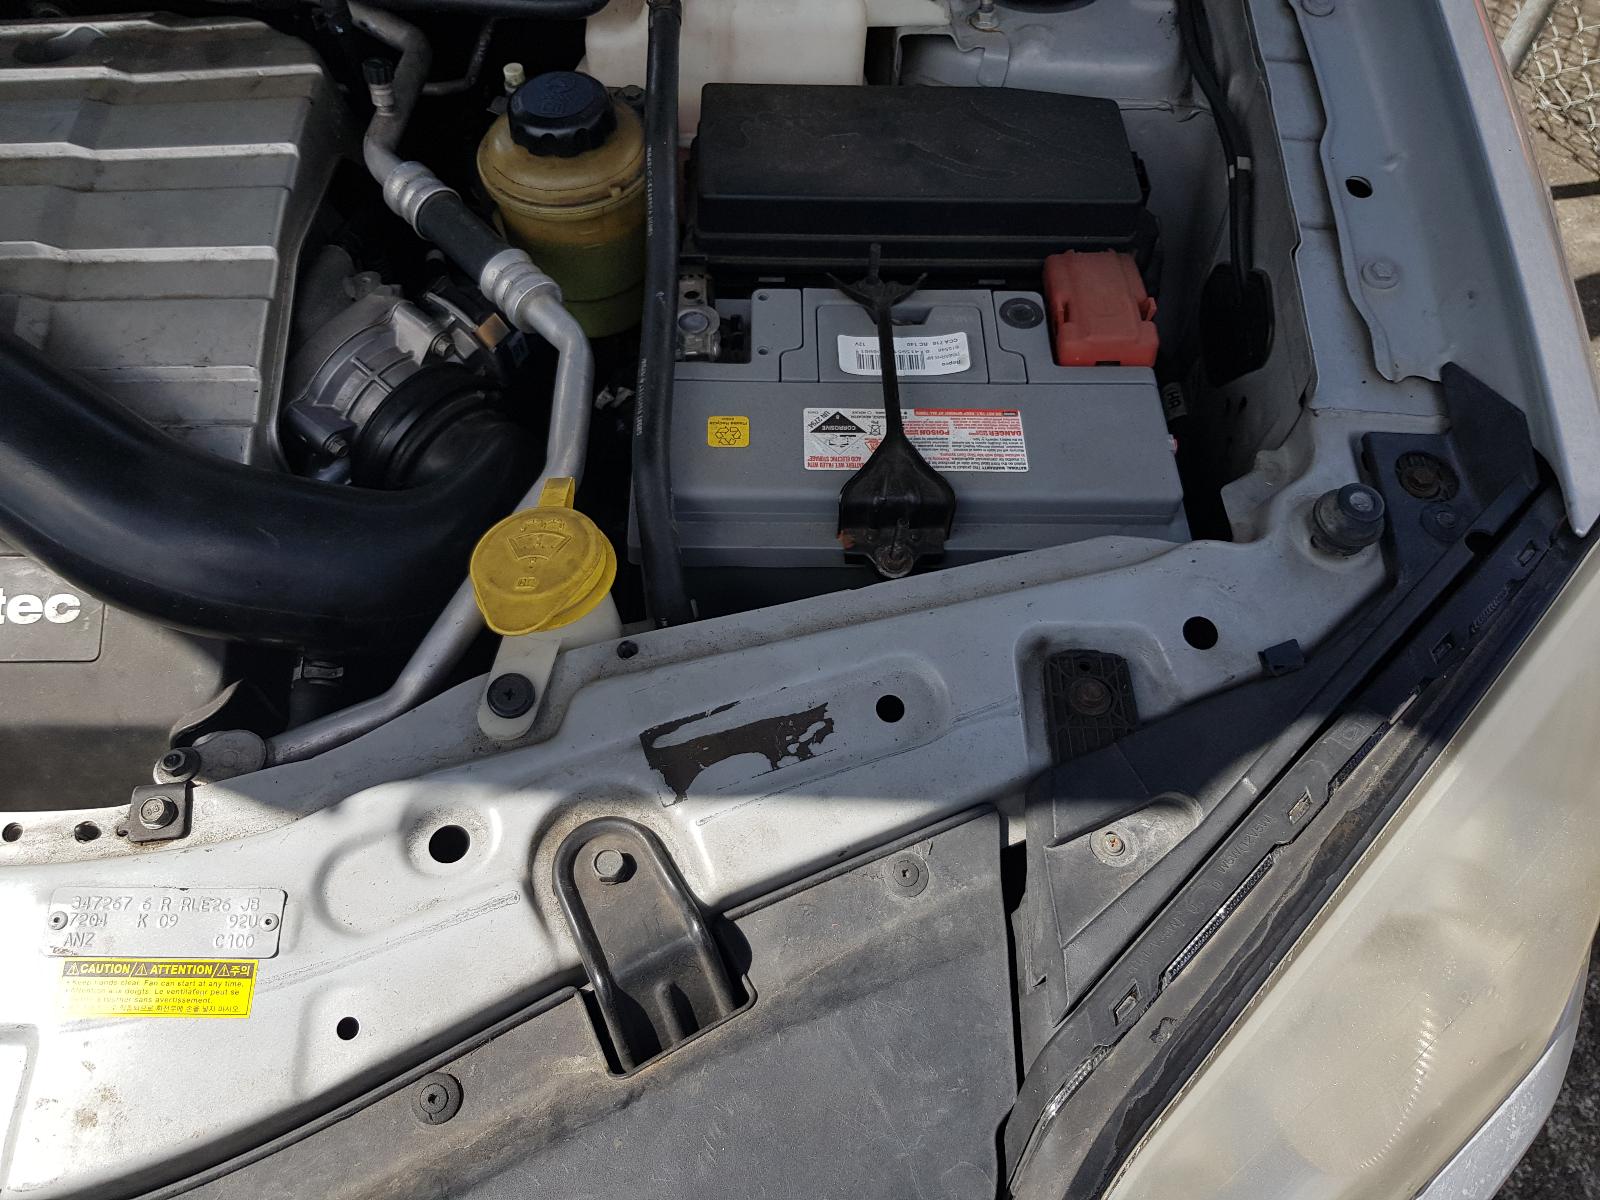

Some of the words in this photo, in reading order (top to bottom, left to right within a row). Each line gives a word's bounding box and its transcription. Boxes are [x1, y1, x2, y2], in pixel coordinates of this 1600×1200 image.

[72, 895, 132, 911] 347267
[142, 896, 152, 911] 6
[161, 897, 172, 911] R
[137, 913, 149, 928] K
[160, 914, 178, 928] 09
[63, 932, 96, 948] ANZ
[215, 934, 255, 948] C100
[230, 965, 251, 977] 주의
[208, 981, 221, 989] any
